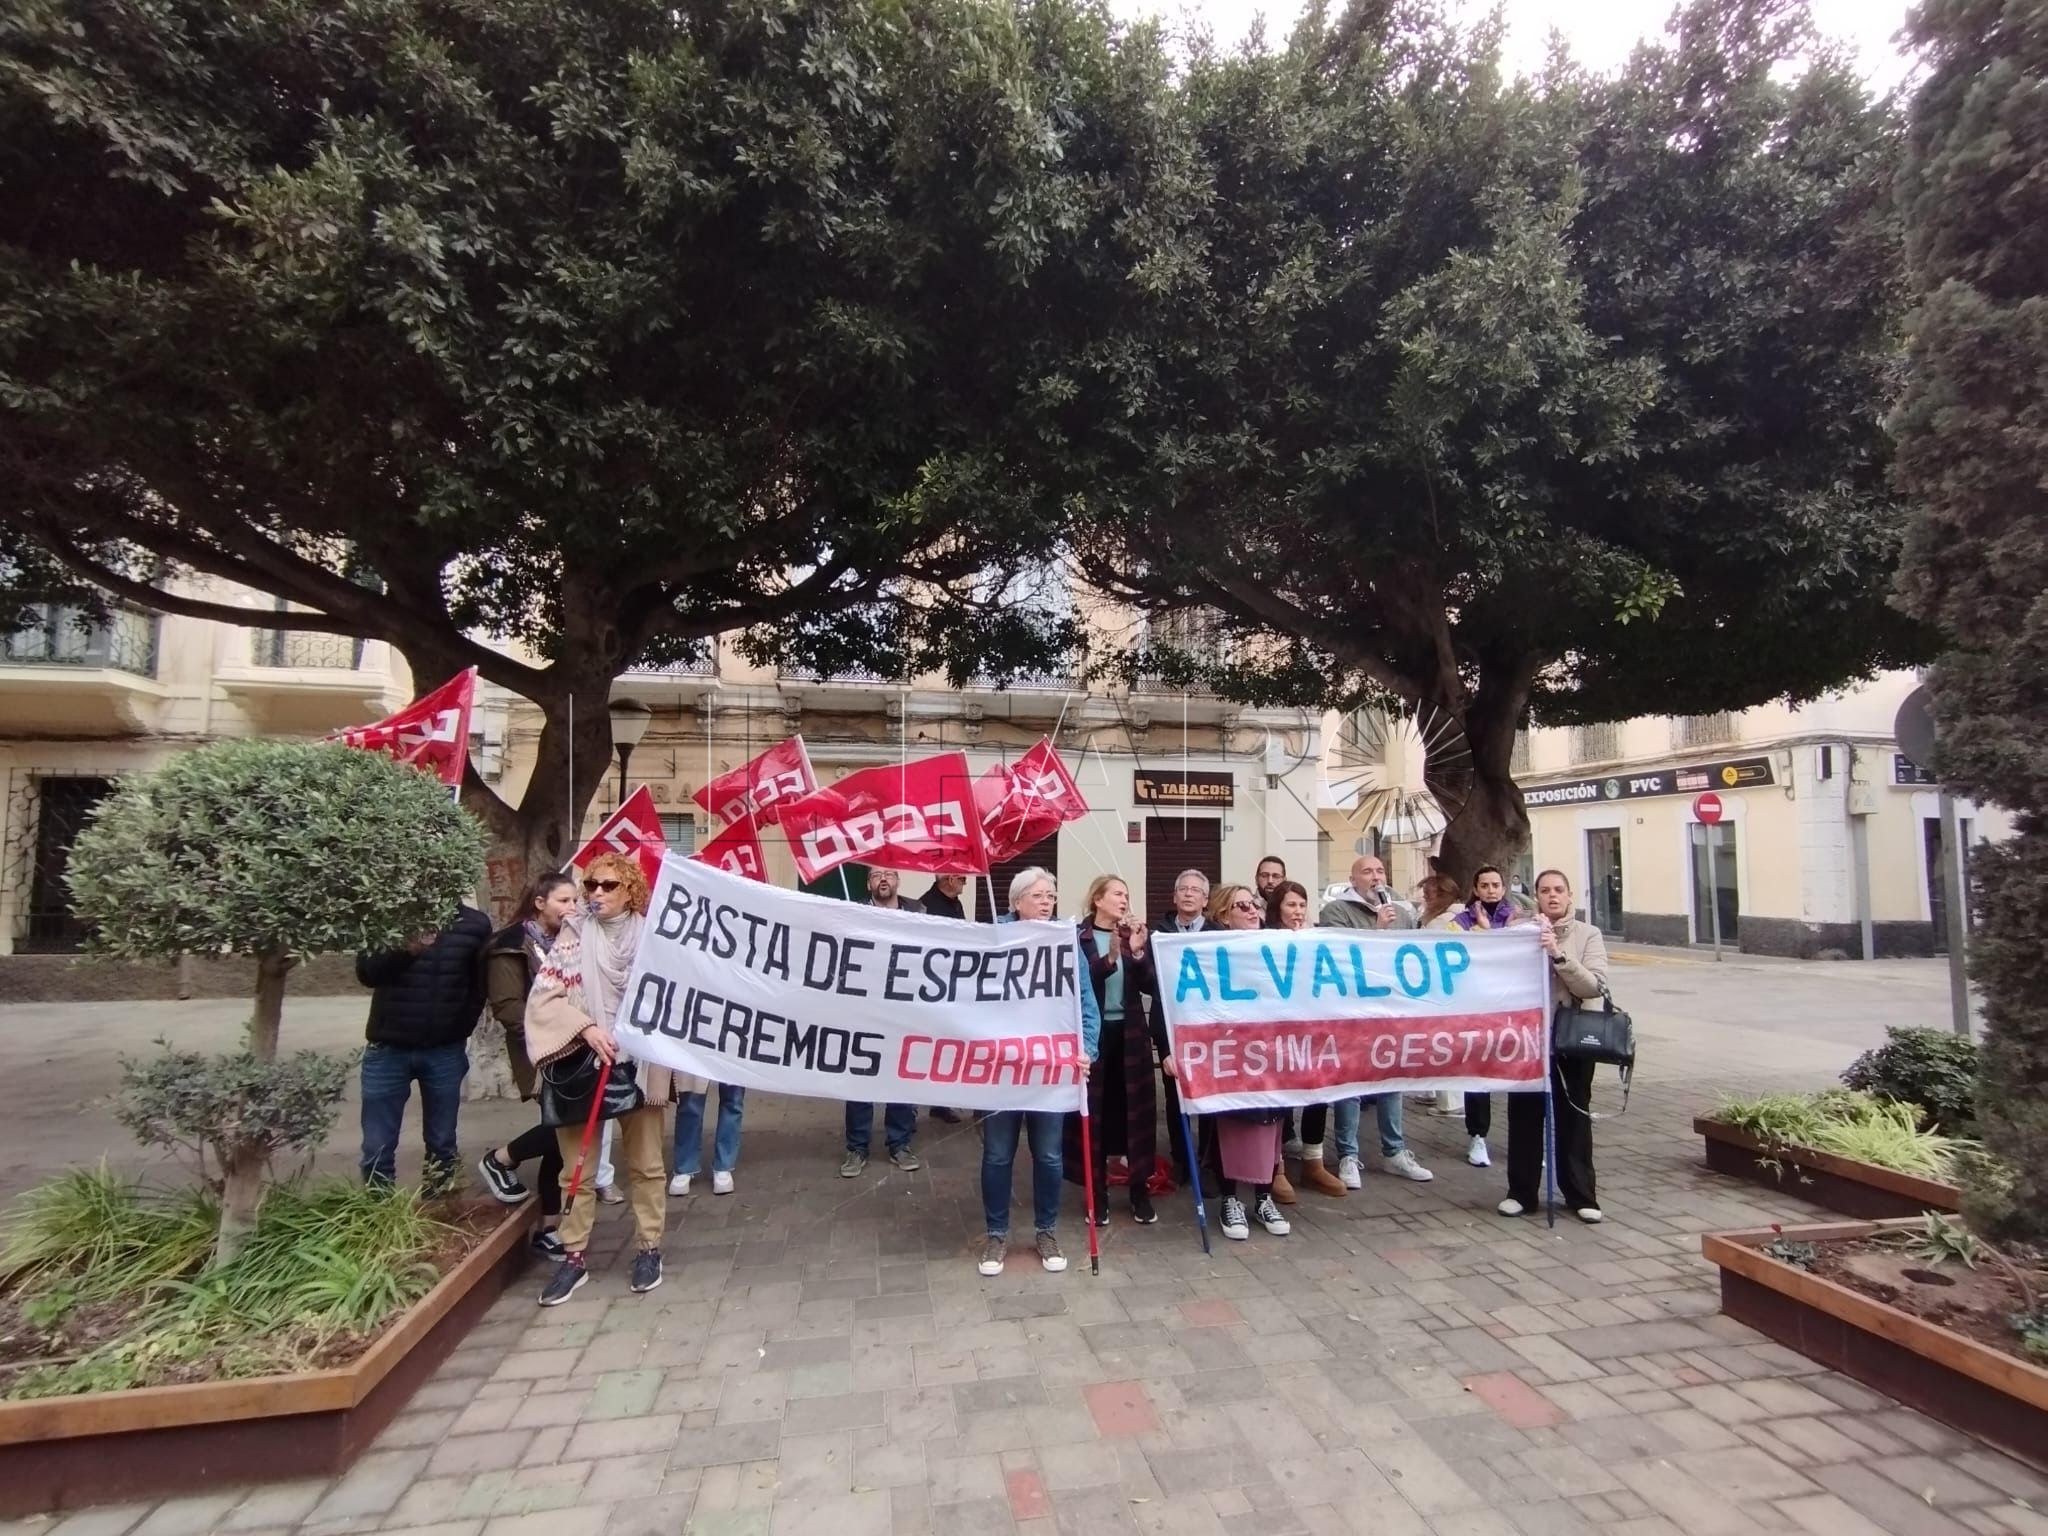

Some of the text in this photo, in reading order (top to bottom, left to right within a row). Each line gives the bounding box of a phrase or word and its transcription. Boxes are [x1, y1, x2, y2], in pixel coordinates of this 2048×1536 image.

[1161, 784, 1230, 795] TABACOS
[1524, 784, 1597, 804] EXPOSICIÓN
[1630, 777, 1661, 793] PVC
[655, 883, 1075, 1002] BASTA DE ESPERAR
[1176, 941, 1471, 1003] ALVALOP
[630, 972, 1080, 1086] QUEREMOS COBRAR
[1183, 1015, 1542, 1081] PÉSIMA GESTIÓN
